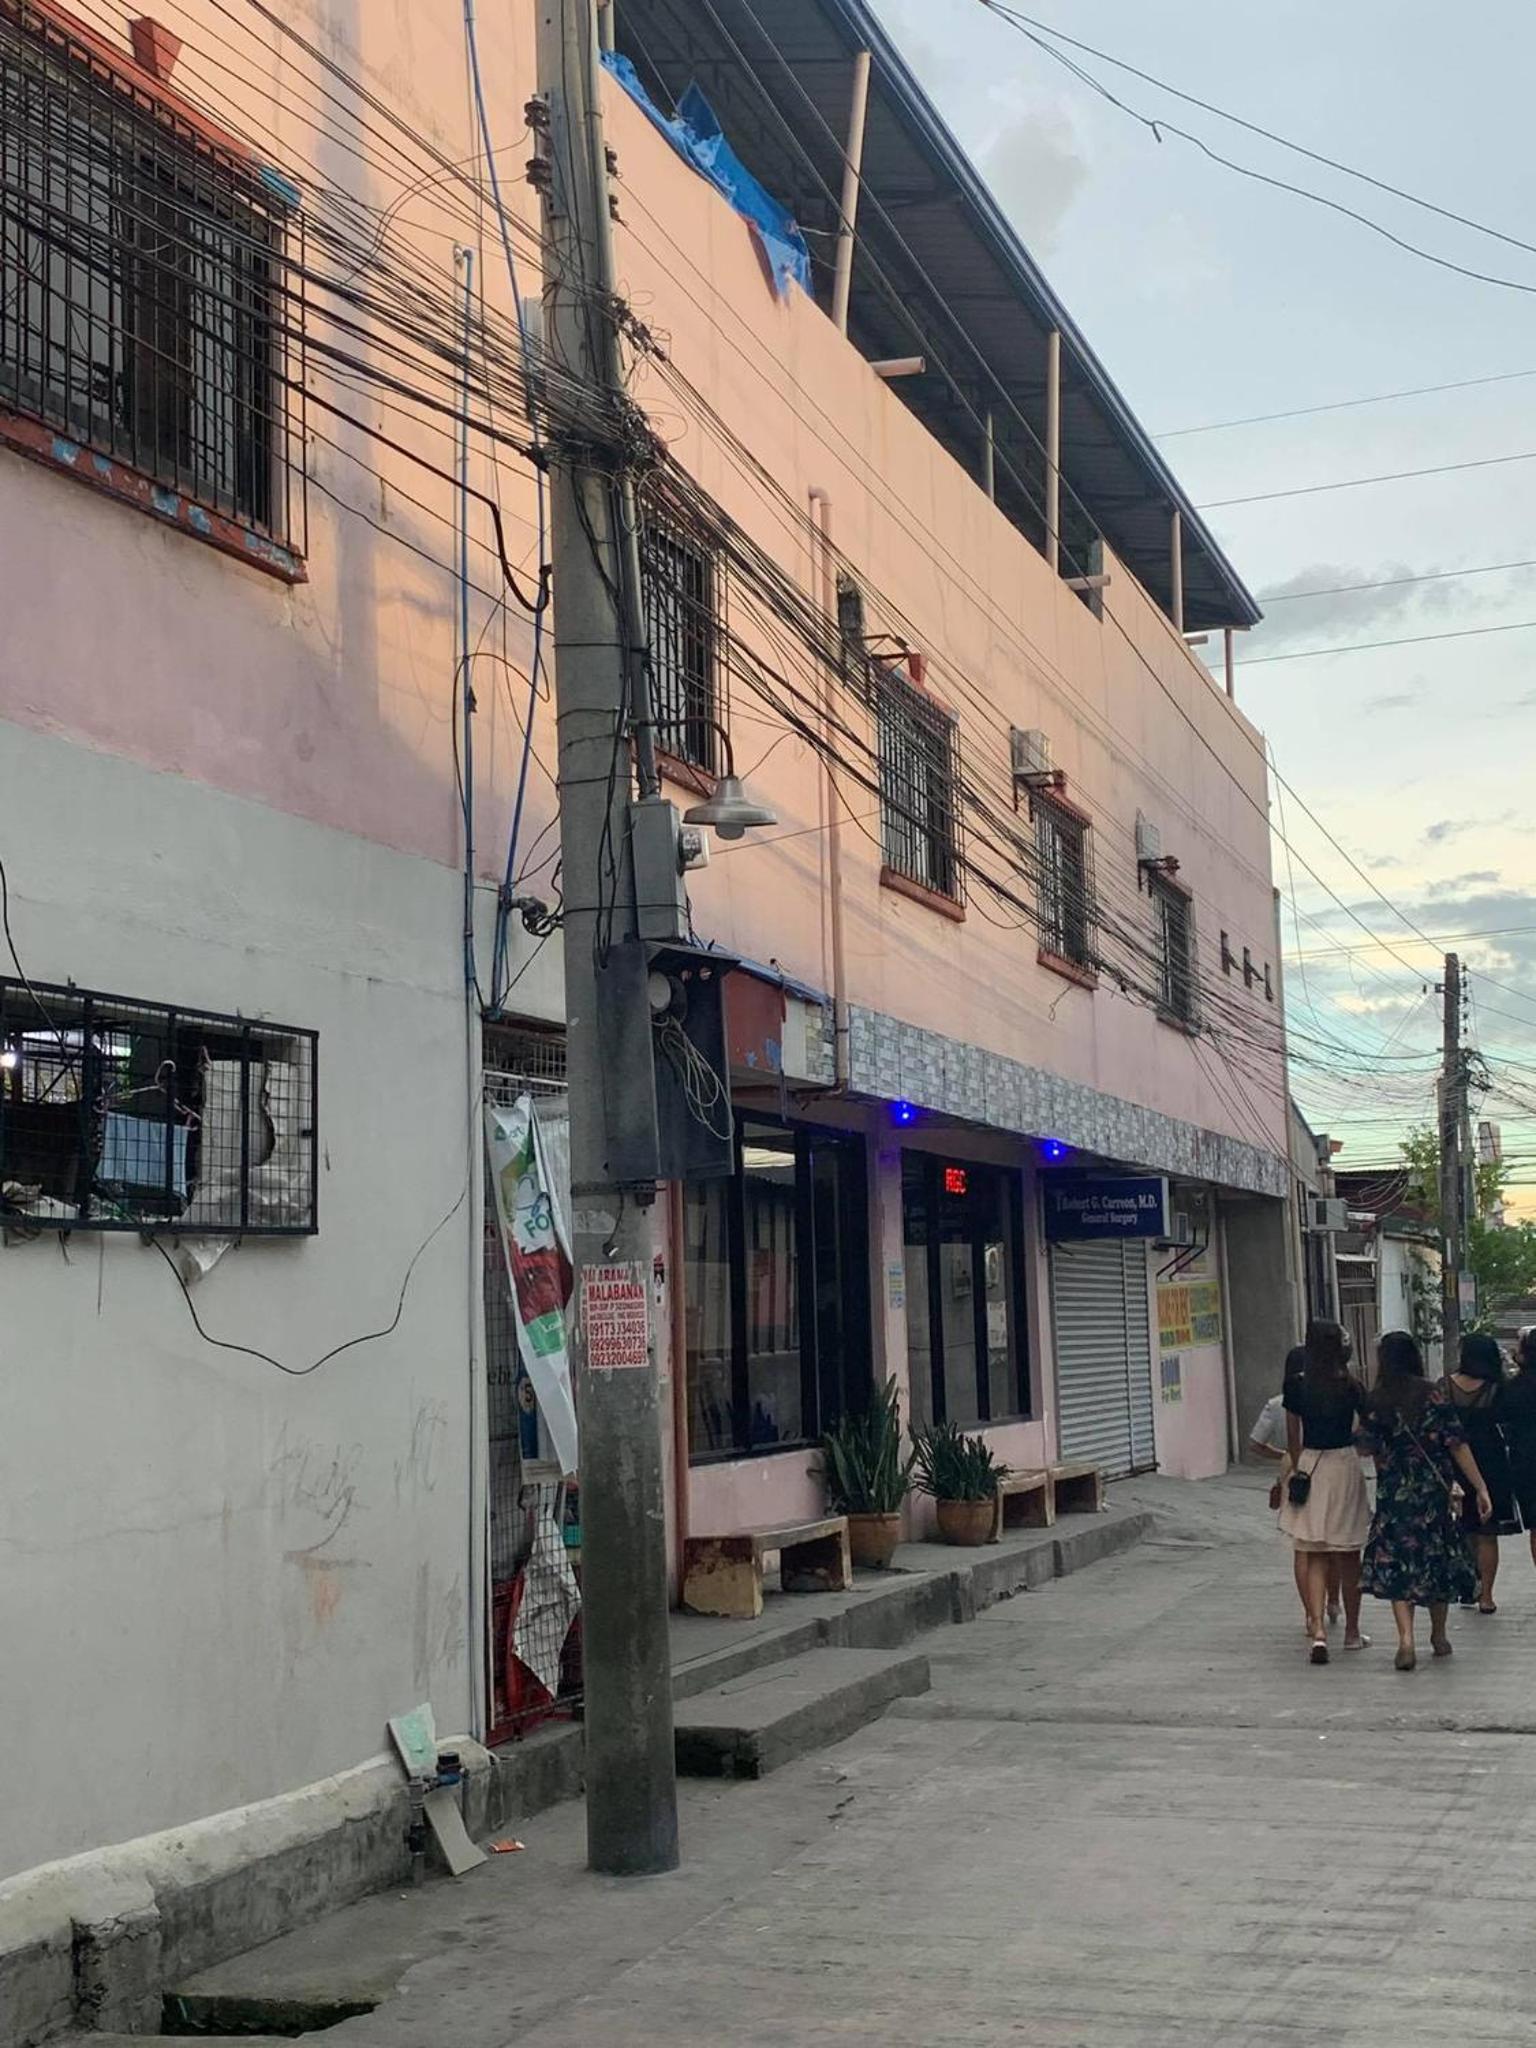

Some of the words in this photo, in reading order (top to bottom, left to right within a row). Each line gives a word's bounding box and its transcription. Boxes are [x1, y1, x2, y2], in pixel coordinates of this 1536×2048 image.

[1138, 1194, 1158, 1209] M.D.
[1081, 1212, 1108, 1224] General
[1111, 1211, 1138, 1226] Surgery
[589, 1283, 644, 1301] MALABANAN
